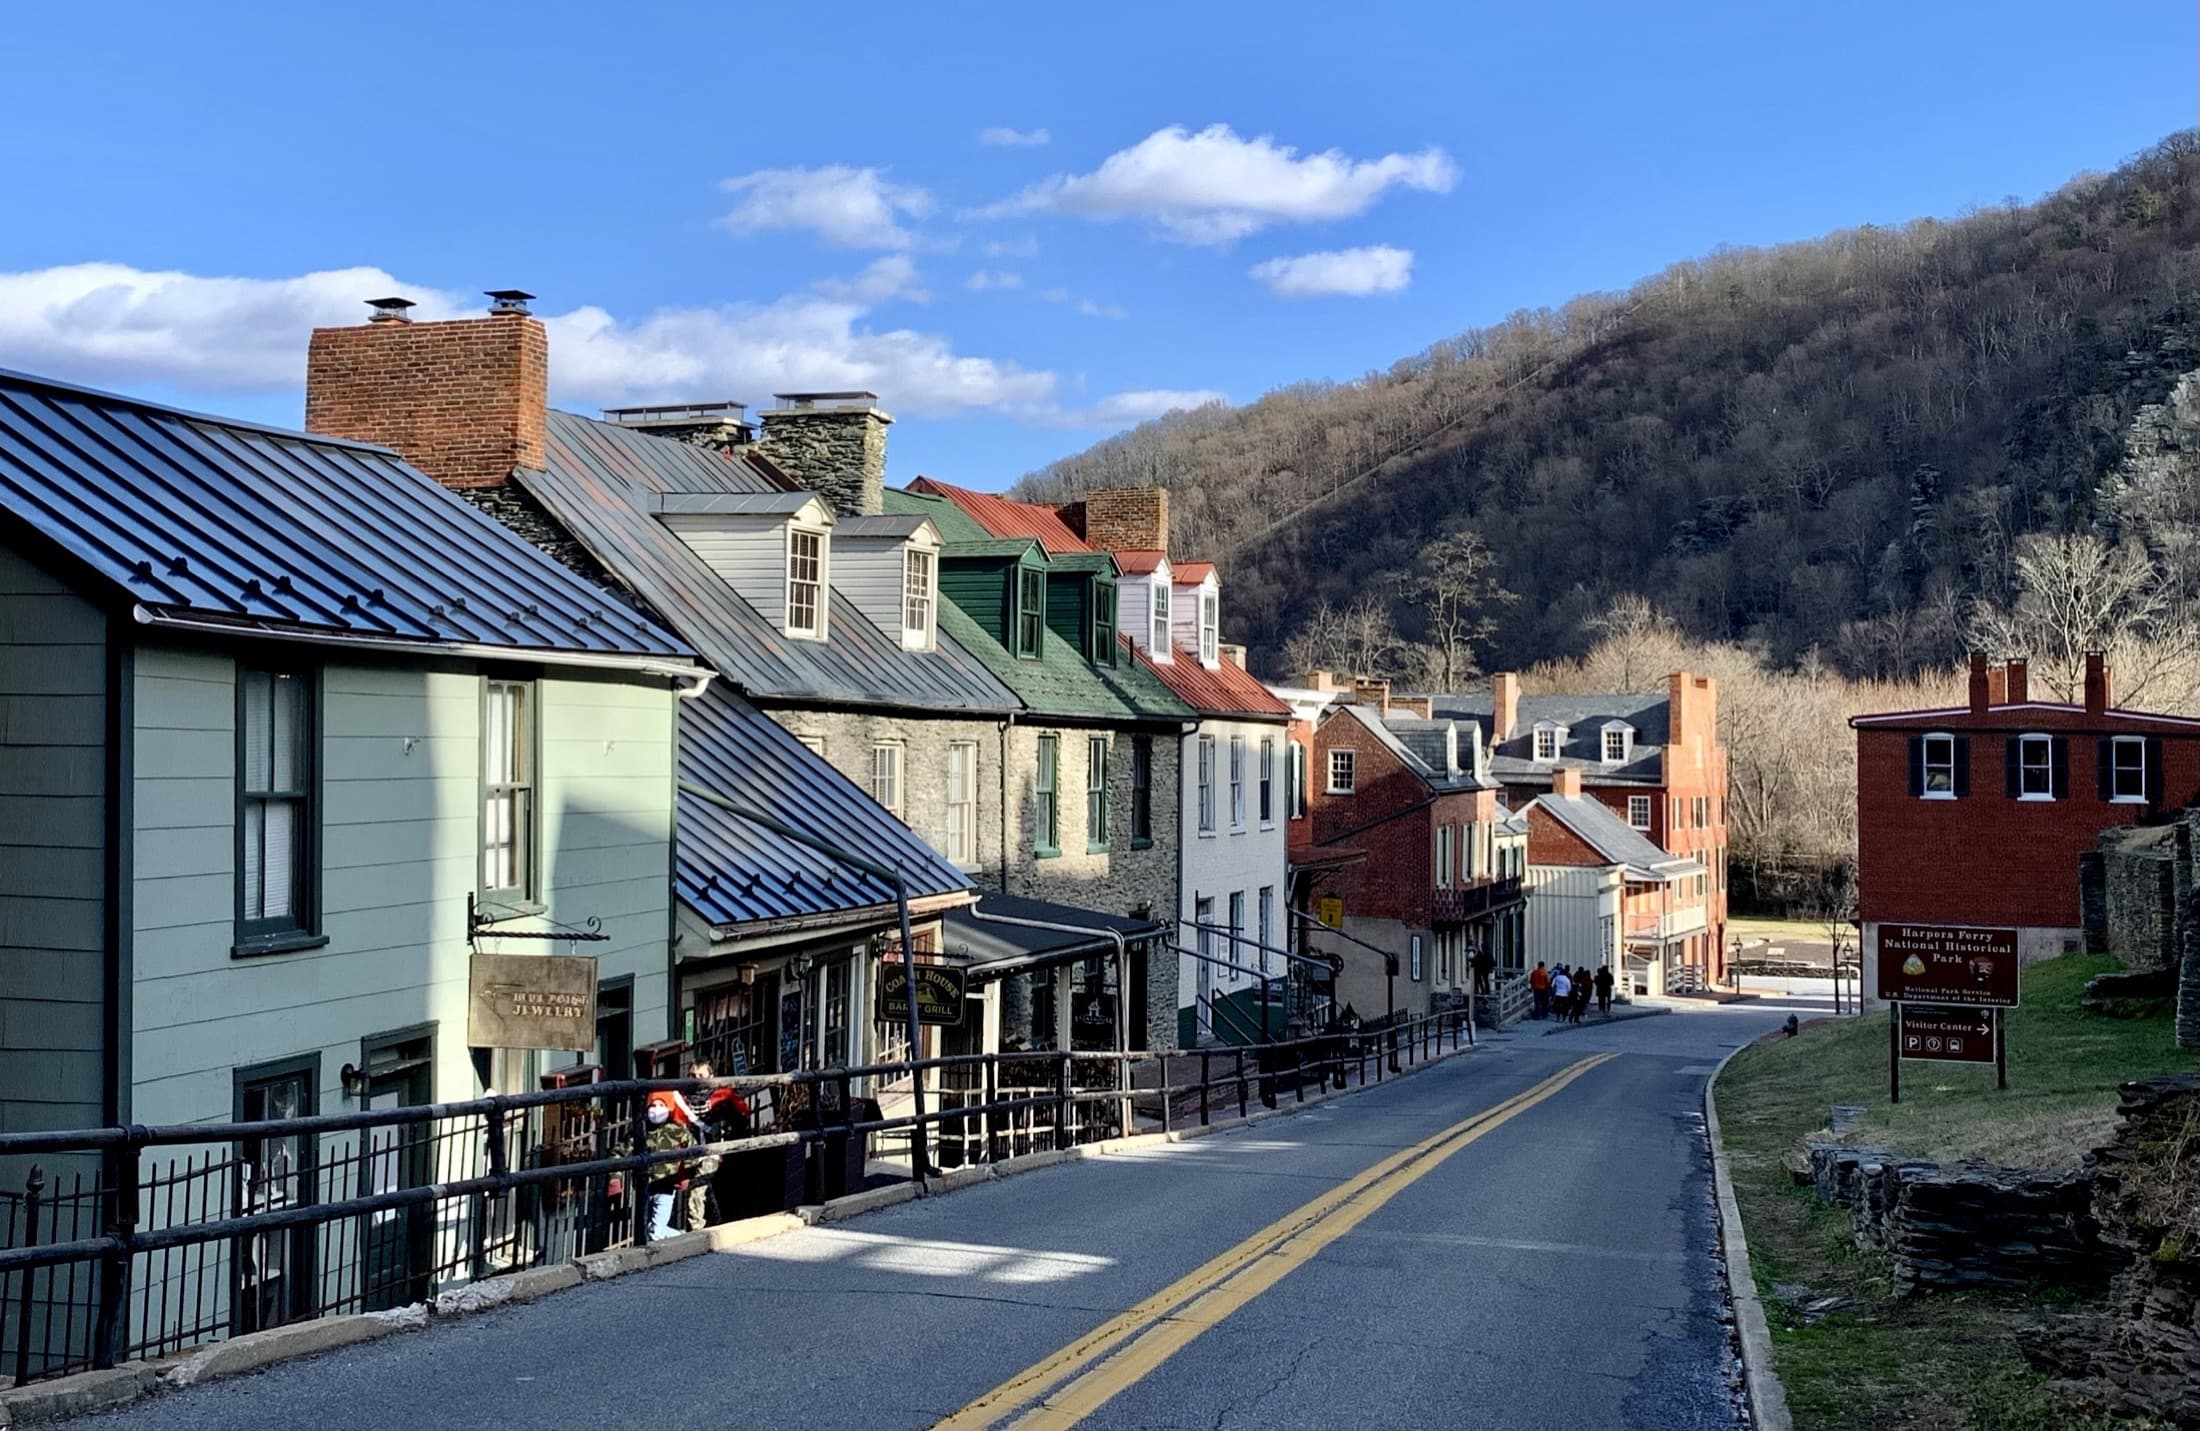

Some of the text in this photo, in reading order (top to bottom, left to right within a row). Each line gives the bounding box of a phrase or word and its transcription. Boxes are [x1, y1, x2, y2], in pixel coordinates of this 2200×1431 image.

[1902, 928, 1993, 942] Harpers Ferry
[1885, 939, 2011, 953] National Historical
[1932, 953, 1963, 963] Park
[925, 970, 960, 999] HOUSE
[1904, 985, 1938, 993] National
[1962, 988, 1991, 996] Service
[1904, 993, 1949, 1001] Department
[512, 1005, 582, 1017] JEWELRY
[924, 1005, 953, 1015] GRILL
[1905, 1020, 1973, 1031] Visitor Center
